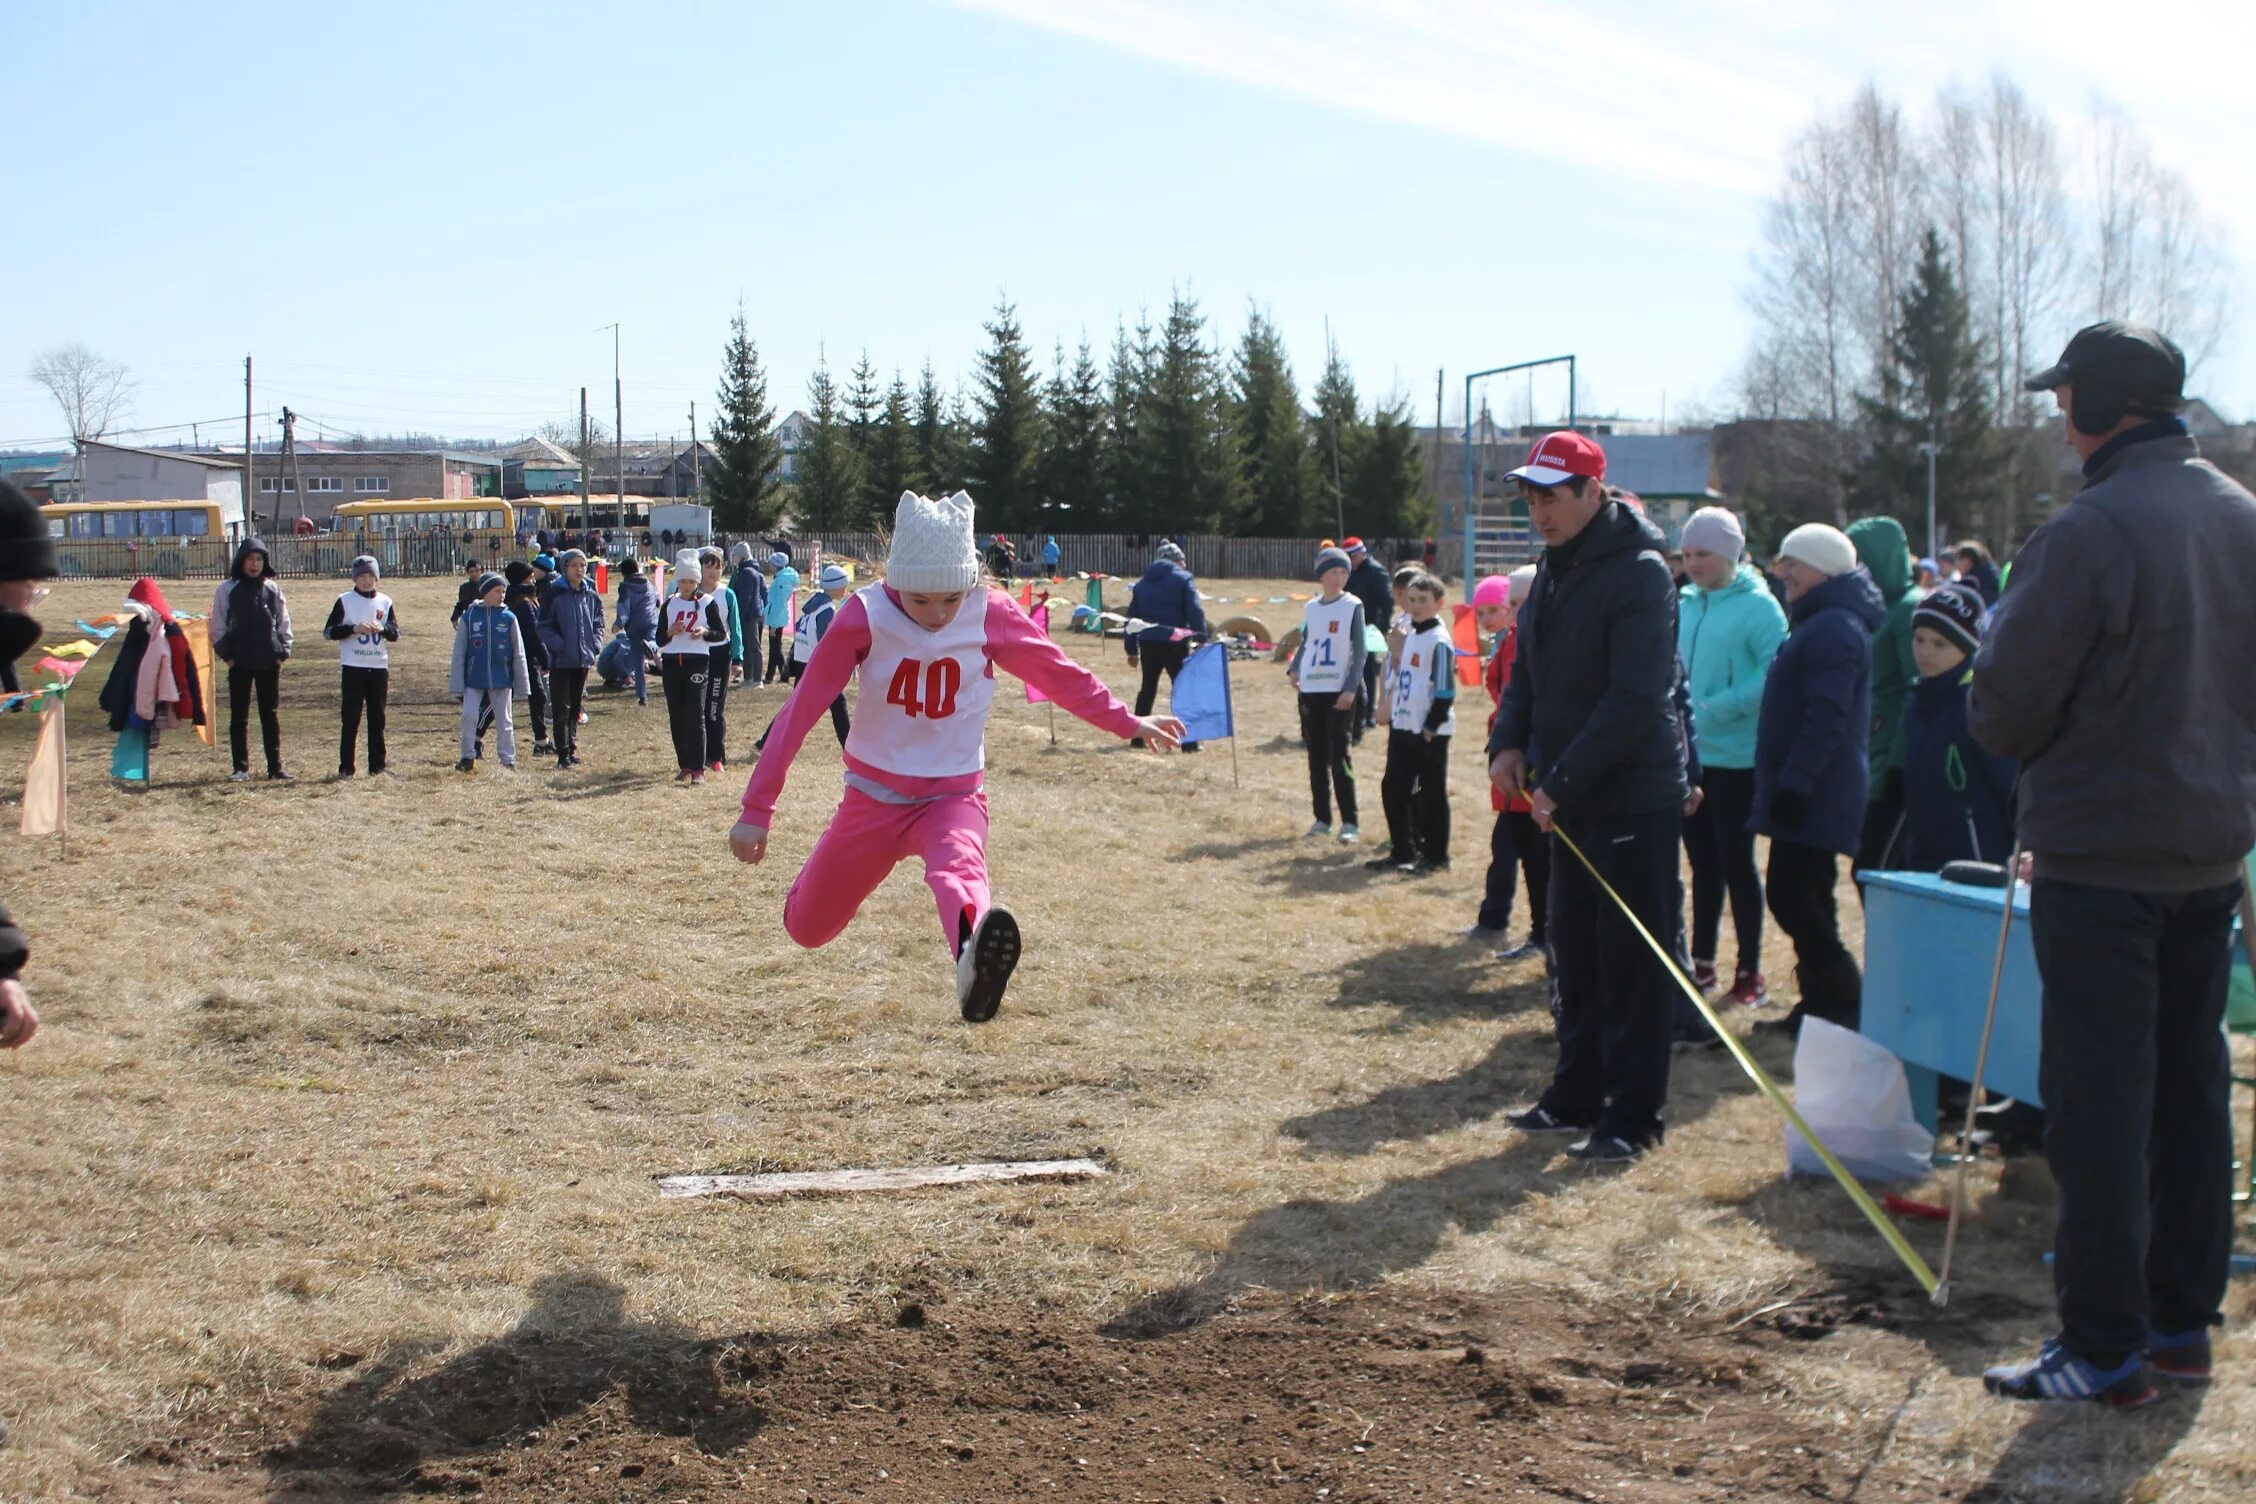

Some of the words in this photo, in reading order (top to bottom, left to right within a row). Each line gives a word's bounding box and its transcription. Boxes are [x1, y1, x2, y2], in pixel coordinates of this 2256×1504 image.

[1540, 454, 1566, 467] RUSSIA
[676, 610, 698, 632] 42
[713, 677, 721, 697] STYLE
[886, 657, 961, 719] 40
